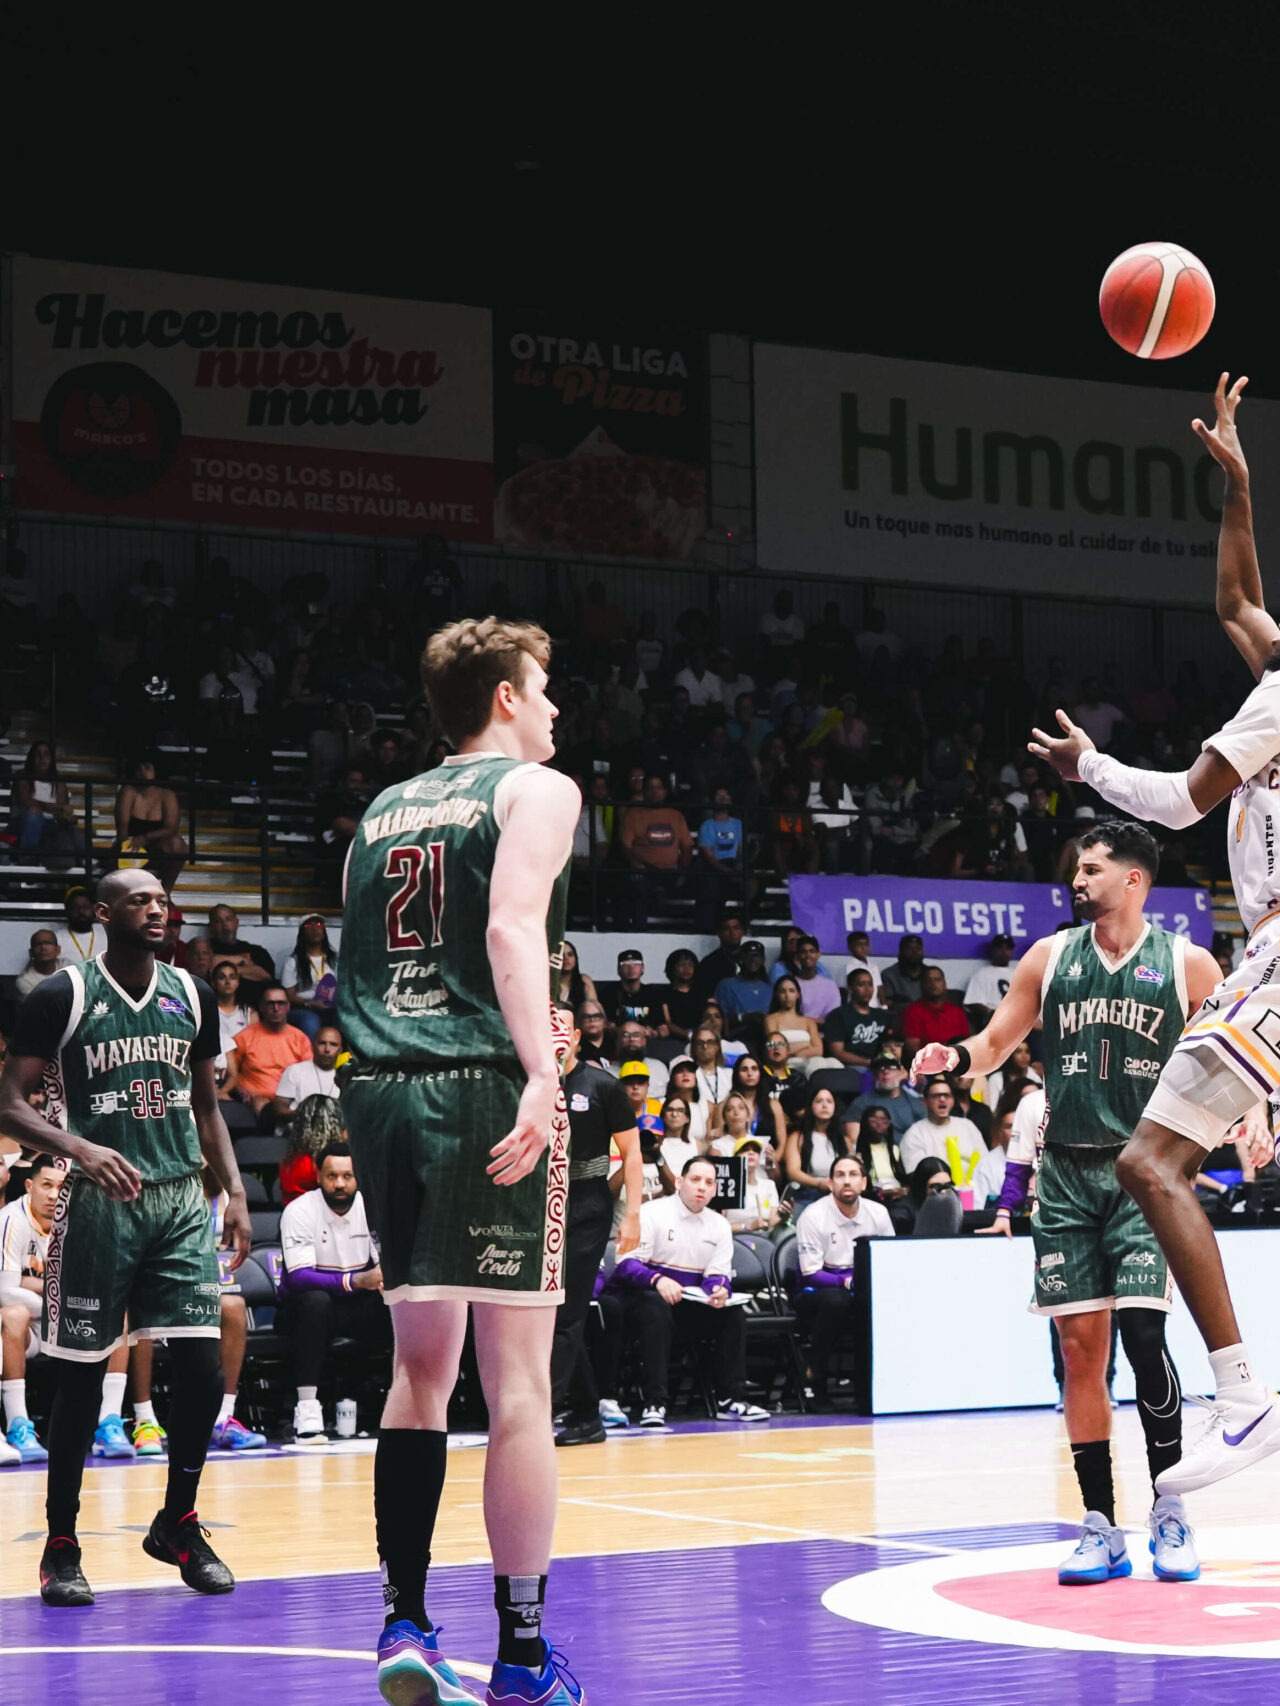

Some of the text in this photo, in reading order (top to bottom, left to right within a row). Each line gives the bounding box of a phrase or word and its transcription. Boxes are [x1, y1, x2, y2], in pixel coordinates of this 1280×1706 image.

[34, 292, 356, 350] Hacemos
[193, 336, 444, 389] nuestra
[510, 333, 689, 378] OTRA LIGA
[246, 386, 430, 427] masa
[512, 360, 687, 417] de Pizza
[191, 457, 402, 496] TODOS LOS DÍAS,
[191, 482, 480, 525] EN CADA RESTAURANTE.
[844, 509, 1218, 558] Un toque mas humano al cuidar de tu sal
[384, 841, 445, 952] 21
[842, 897, 1028, 938] PALCO ESTE
[84, 1033, 192, 1080] MAYAGÜEZ
[1099, 1039, 1110, 1080] 1
[129, 1078, 166, 1119] 35
[182, 1302, 222, 1316] SALU
